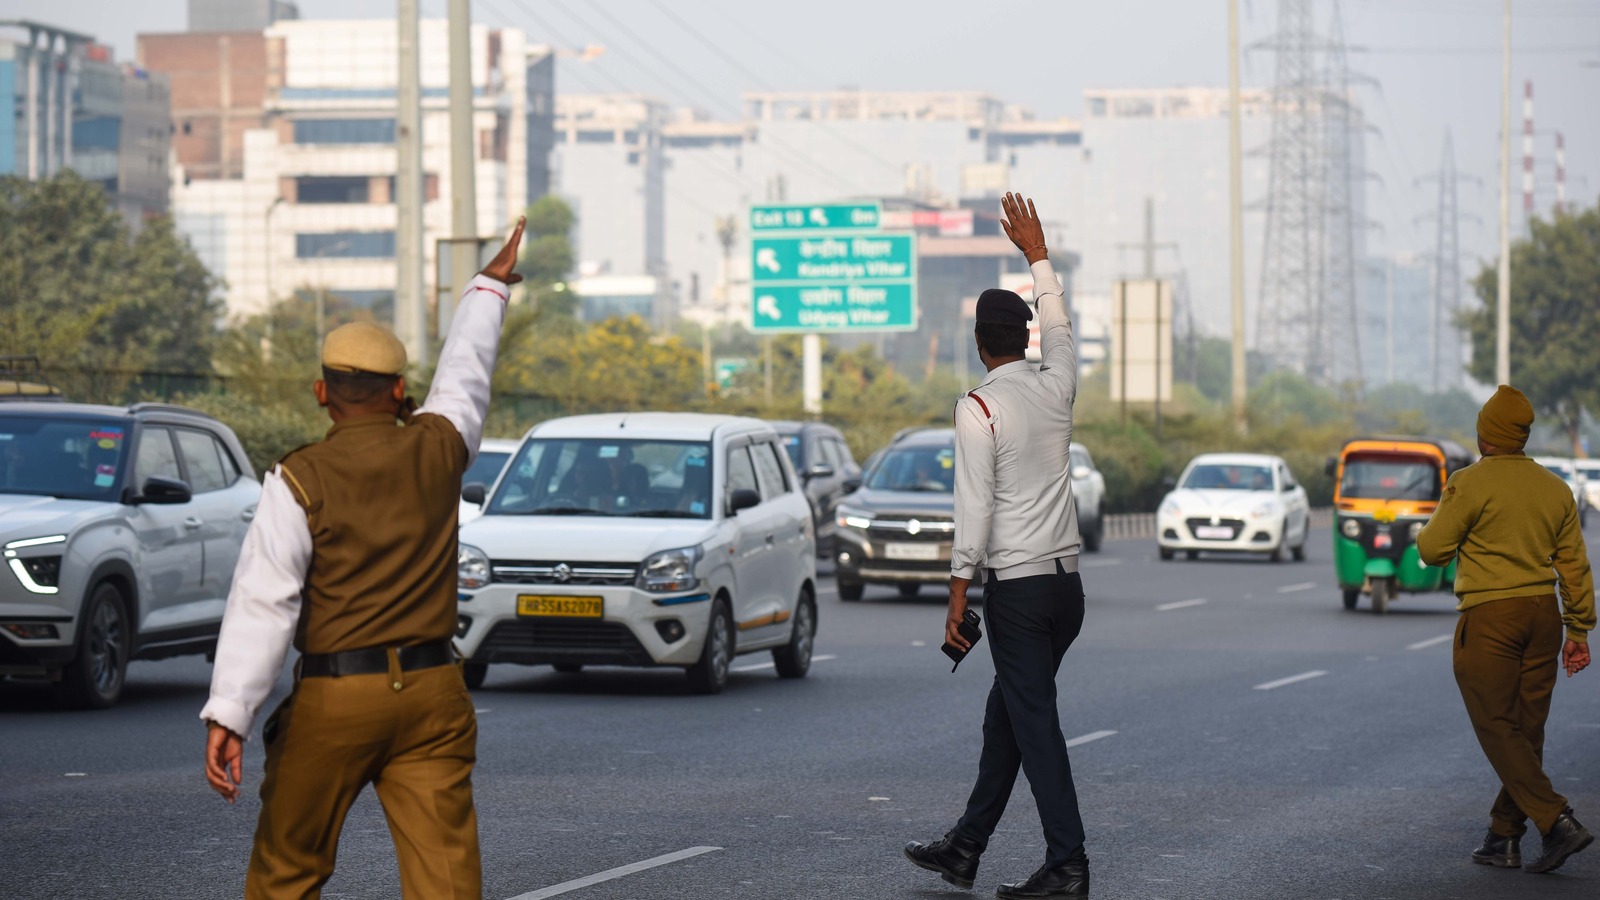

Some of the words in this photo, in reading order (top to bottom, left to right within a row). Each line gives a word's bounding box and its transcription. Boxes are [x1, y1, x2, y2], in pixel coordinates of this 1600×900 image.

[754, 210, 783, 226] Exit
[798, 261, 865, 278] Kendriya
[866, 260, 906, 276] Vihar
[798, 309, 848, 327] Udyog
[849, 308, 890, 323] Vihar
